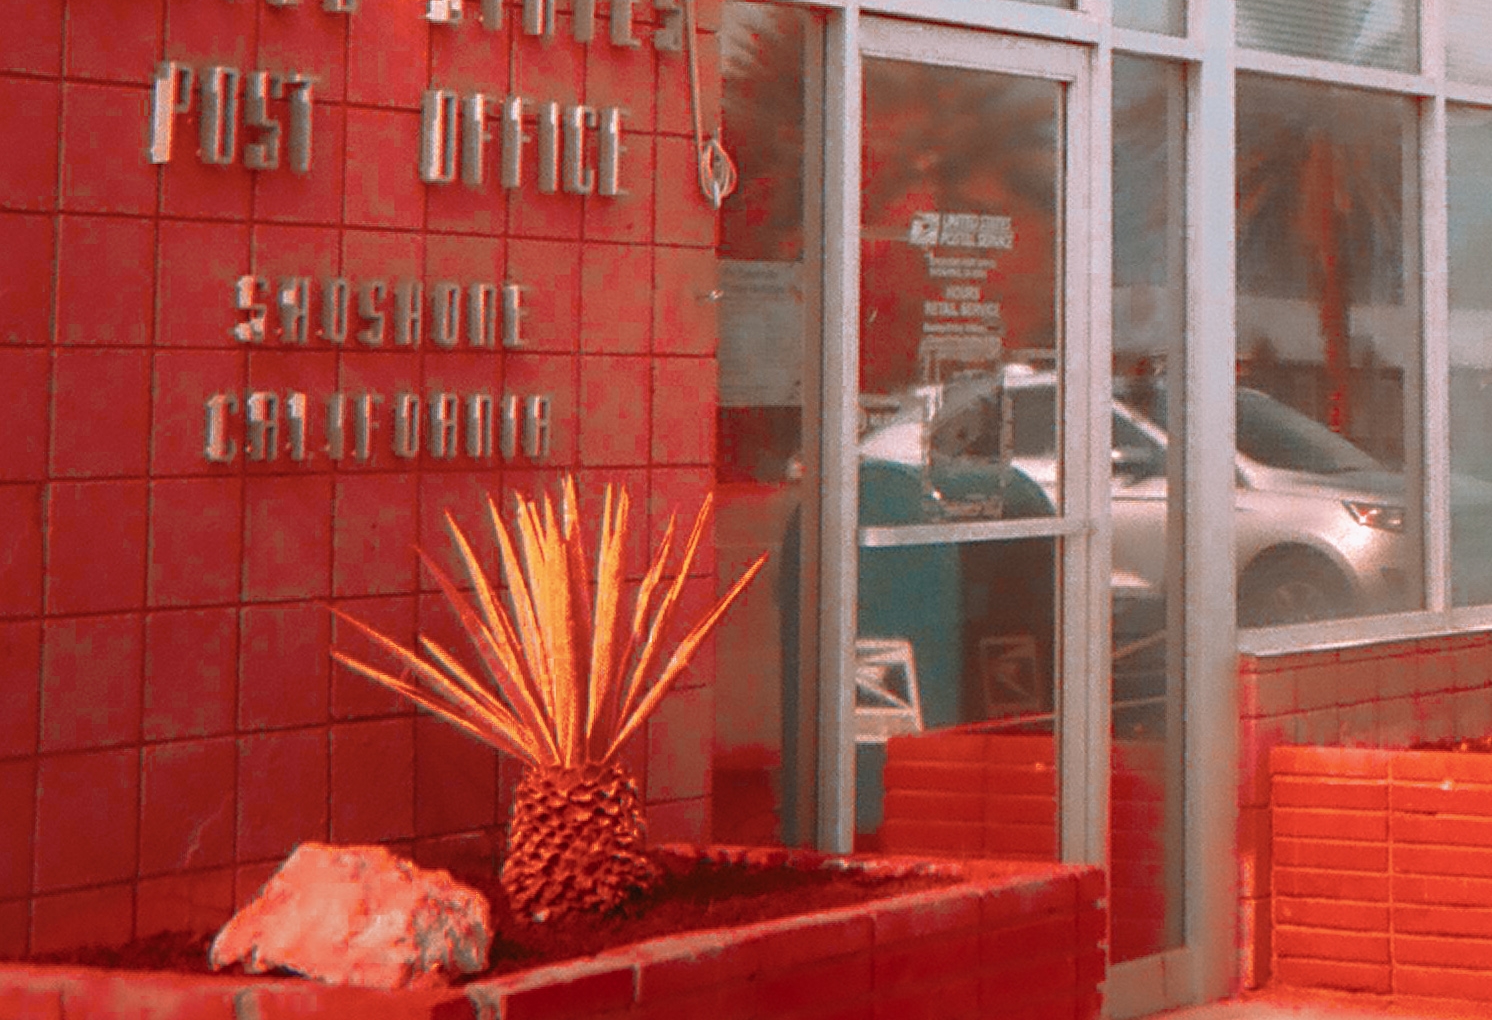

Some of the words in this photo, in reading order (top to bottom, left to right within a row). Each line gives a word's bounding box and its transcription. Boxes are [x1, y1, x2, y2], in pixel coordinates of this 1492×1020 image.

[148, 60, 314, 173] POST
[419, 89, 628, 196] OFFICE
[235, 275, 527, 348] SHOSHONE
[203, 391, 552, 461] CALIFORNIA
